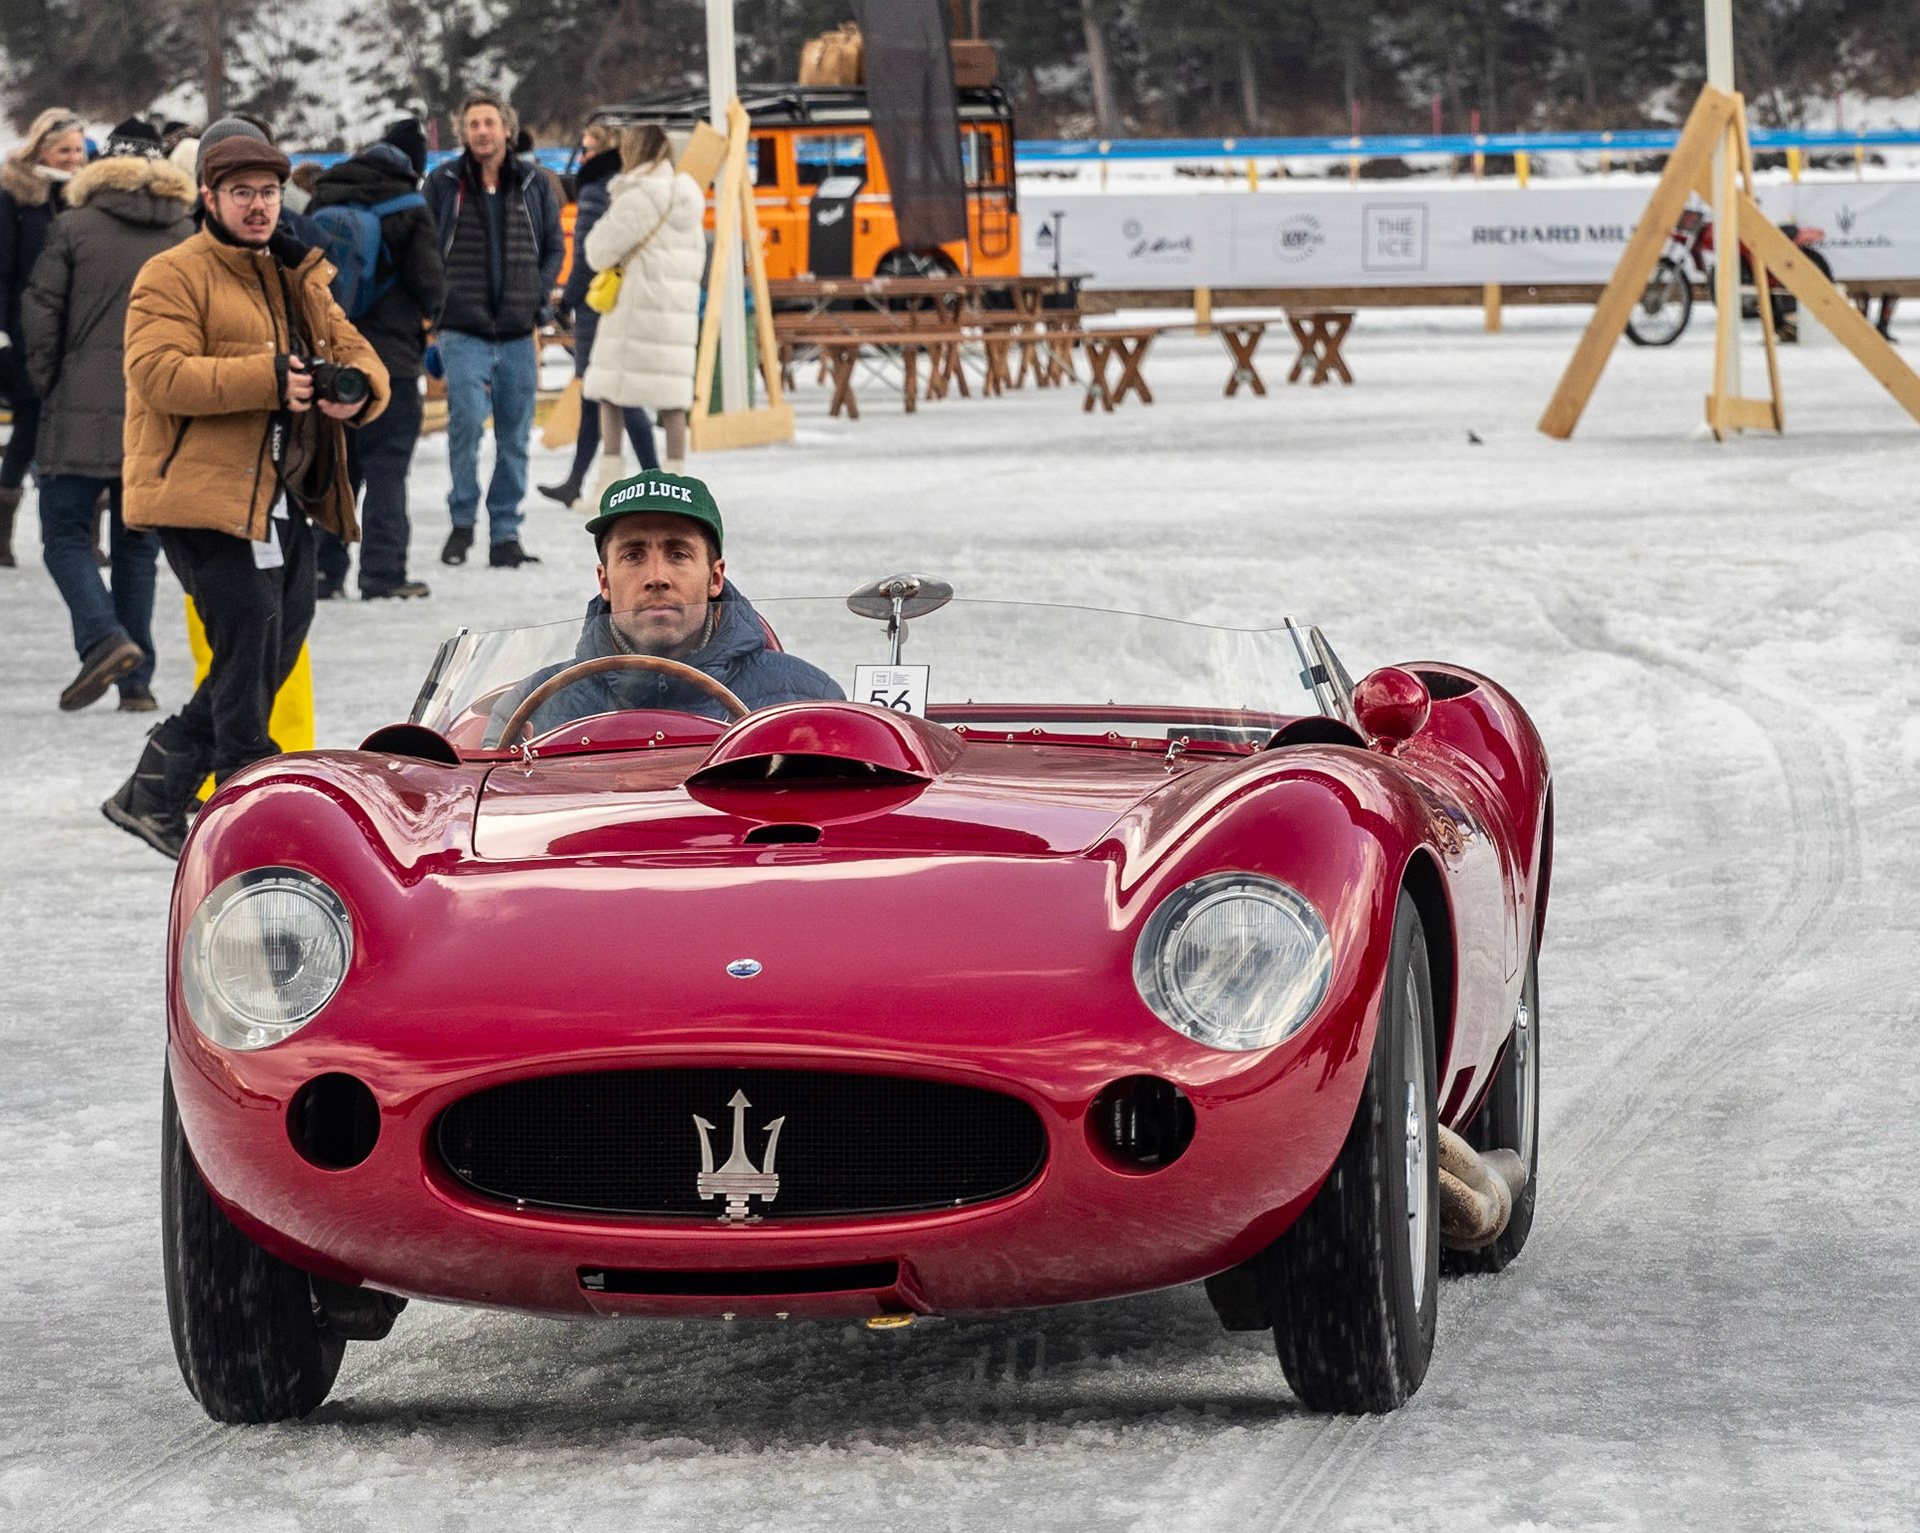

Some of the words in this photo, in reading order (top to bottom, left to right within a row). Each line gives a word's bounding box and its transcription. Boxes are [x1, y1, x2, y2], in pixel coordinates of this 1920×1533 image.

[1375, 216, 1414, 236] THE
[1472, 225, 1580, 244] RICHARD
[1586, 224, 1637, 244] MIL
[1377, 239, 1414, 258] ICE
[609, 482, 646, 508] GOOD
[649, 481, 693, 504] LUCK
[870, 689, 912, 714] 56
